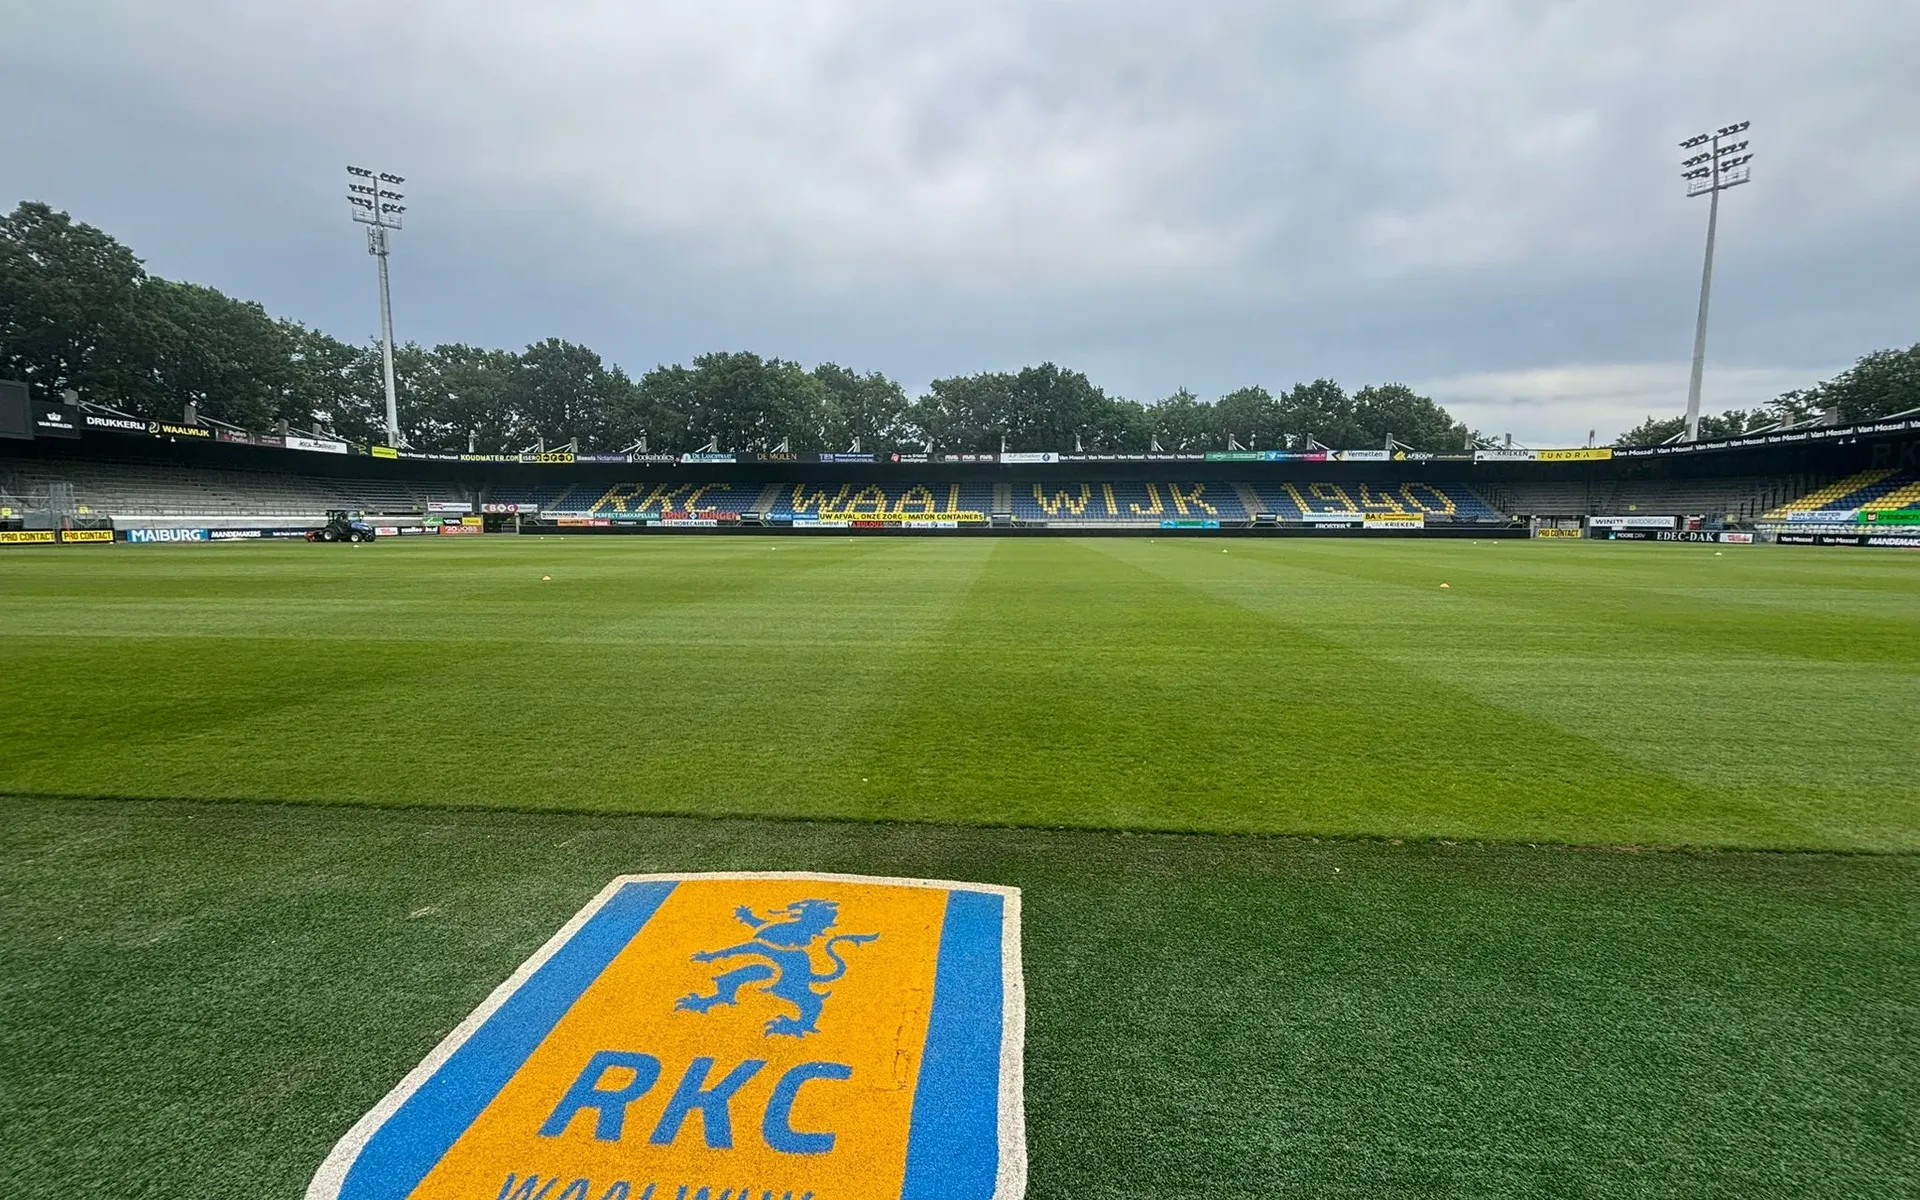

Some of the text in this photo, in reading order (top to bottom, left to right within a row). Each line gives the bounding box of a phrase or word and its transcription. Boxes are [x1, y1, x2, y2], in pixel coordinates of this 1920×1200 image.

[86, 416, 210, 437] DRUKKERIJ WAALWIJK
[1874, 421, 1905, 431] Mossel
[1826, 427, 1853, 436] Mossel
[1743, 437, 1766, 445] Mossel
[1782, 432, 1807, 441] Mossel
[1707, 441, 1728, 449] Mossel
[633, 452, 674, 461] Cookaholics
[1540, 451, 1590, 459] TUNDRA
[1628, 448, 1653, 456] Mossel
[460, 454, 519, 462] KOUDWATER.COM
[590, 483, 1456, 515] RKC WAAL WIJK 1940
[661, 511, 688, 519] ARNO
[1, 532, 54, 542] PRO CONTACT
[64, 531, 112, 541] PRO CONTACT
[132, 529, 200, 542] MAIBURG
[211, 530, 262, 538] MANDEMAKERS
[1551, 529, 1579, 537] CONTACT
[1657, 531, 1715, 542] EDEC-DAK
[537, 1050, 853, 1156] RKC
